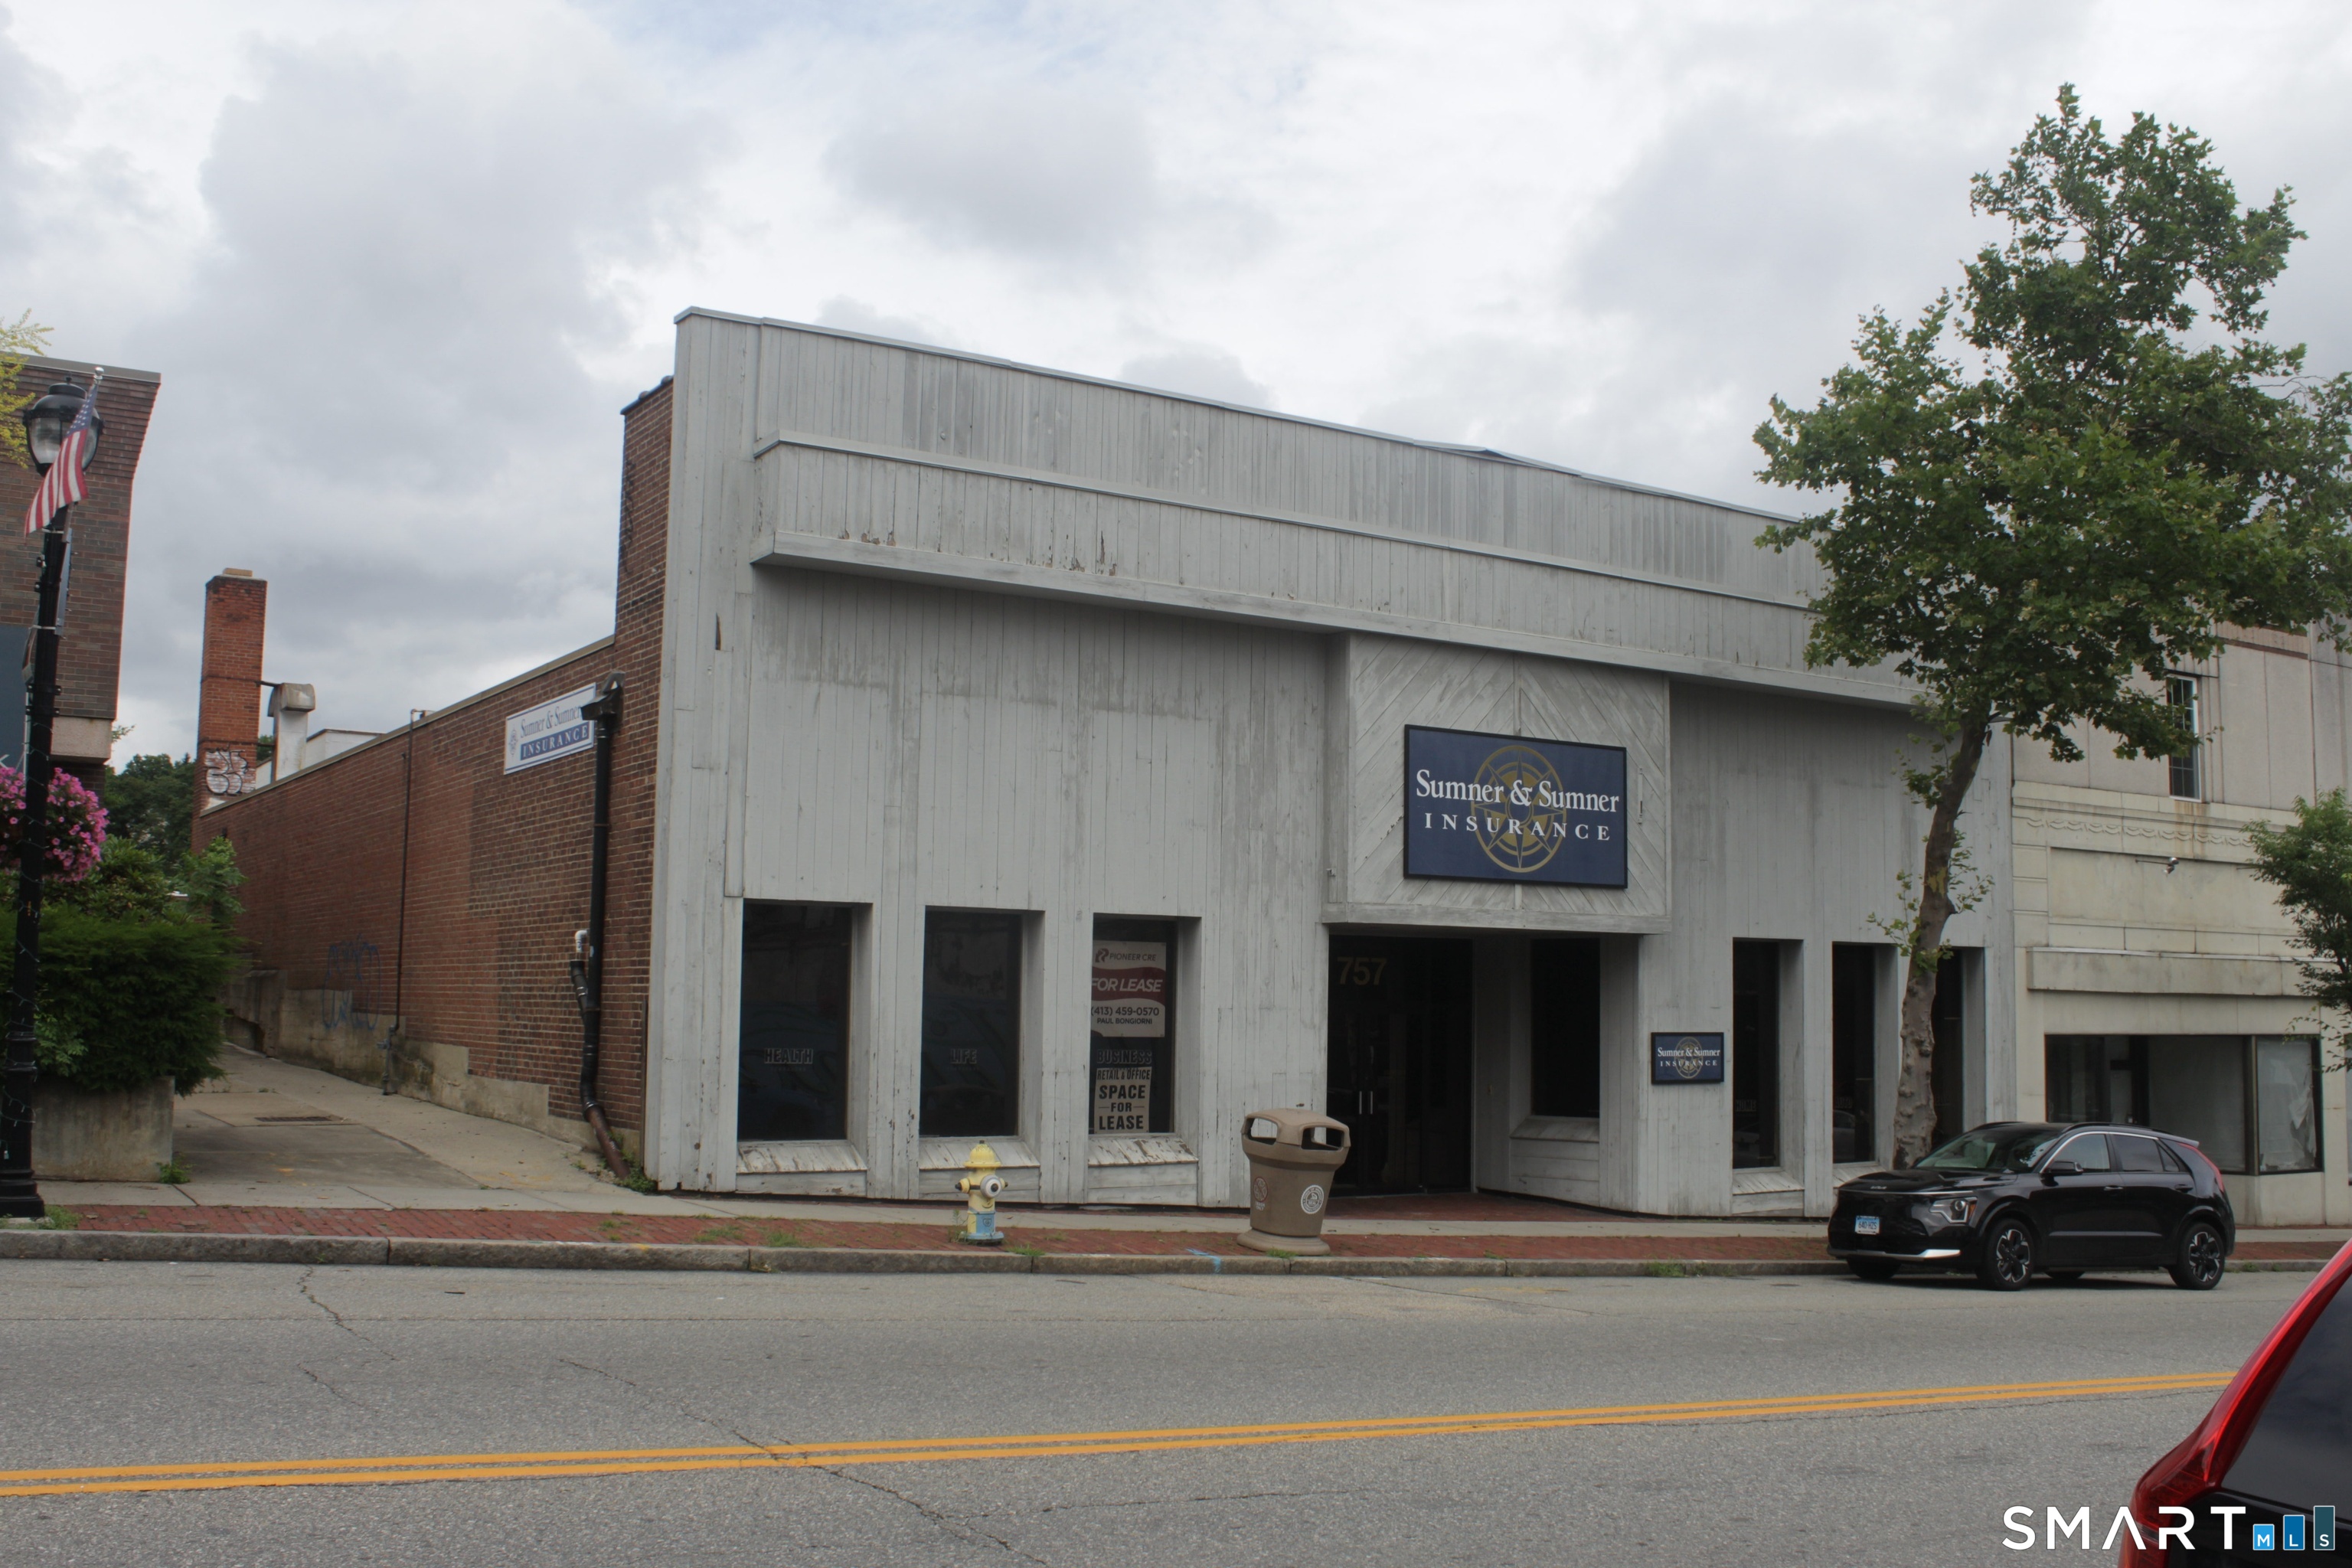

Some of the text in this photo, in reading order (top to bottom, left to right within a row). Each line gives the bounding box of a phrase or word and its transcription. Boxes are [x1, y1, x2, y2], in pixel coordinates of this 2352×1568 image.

[521, 719, 545, 738] Sumner
[546, 710, 554, 729] &
[523, 725, 587, 757] INSURANCE
[1416, 769, 1619, 812] Sumner & Sumner
[1425, 812, 1610, 841] INSURANCE
[1109, 952, 1142, 961] PIONEER
[1336, 956, 1388, 986] 757
[1119, 978, 1164, 992] LEASE
[1091, 1006, 1159, 1017] (413) 459-0570
[764, 1047, 814, 1064] HEALTH
[950, 1047, 978, 1064] LIFE
[1096, 1049, 1152, 1064] BUSINESS
[1658, 1047, 1720, 1057] Sumner & Sumner
[1097, 1070, 1119, 1080] RETAIL
[1121, 1071, 1125, 1080] &
[1126, 1069, 1150, 1080] OFFICE
[1099, 1085, 1146, 1099] SPACE
[1111, 1102, 1132, 1112] FOR
[1099, 1116, 1144, 1130] LEASE
